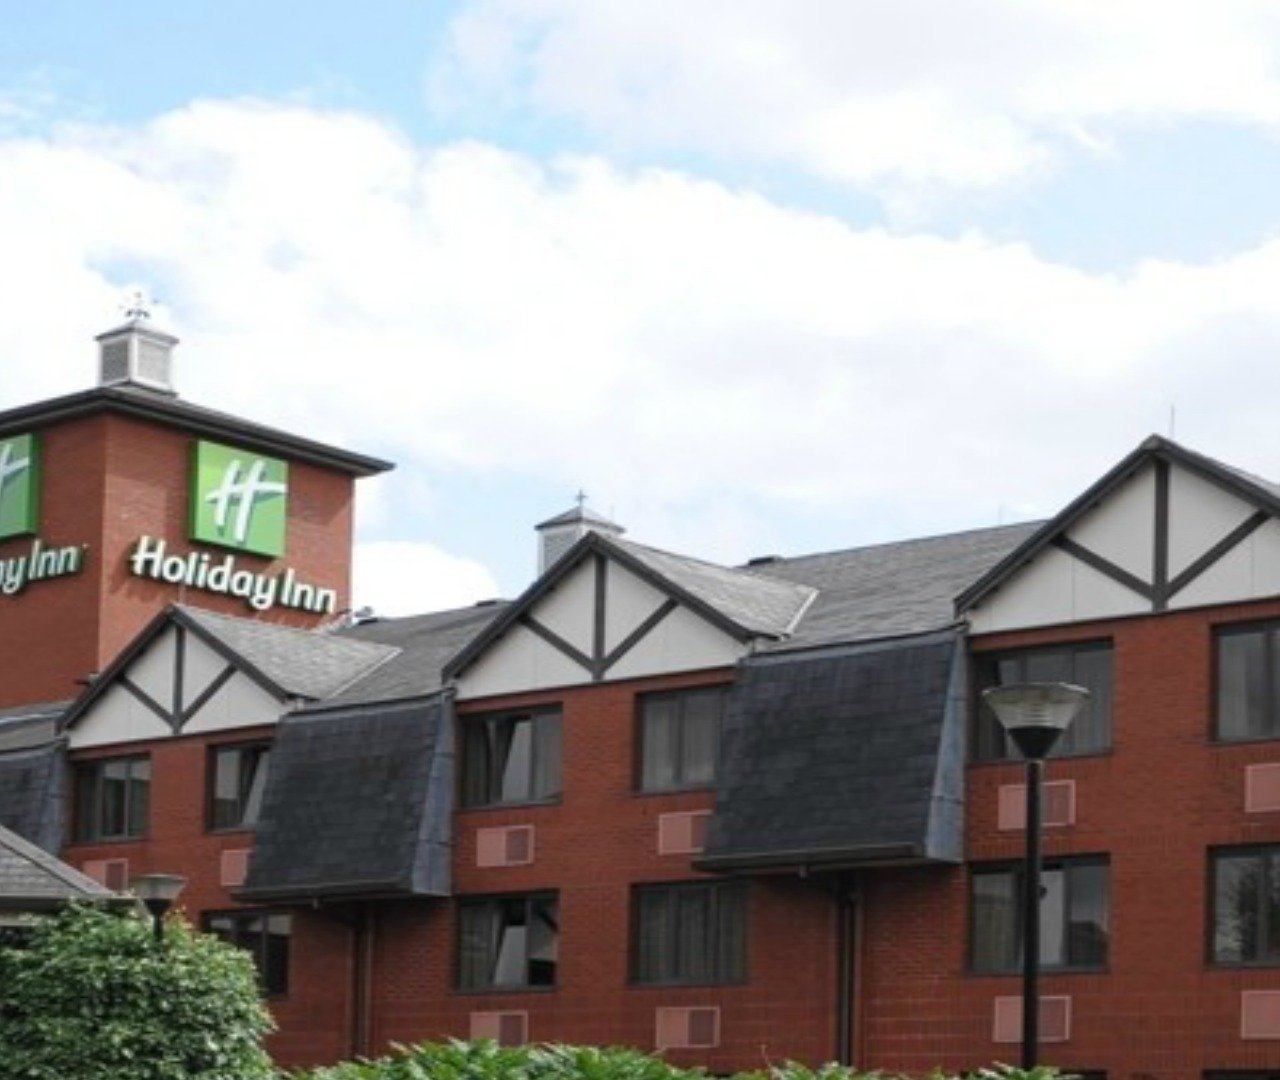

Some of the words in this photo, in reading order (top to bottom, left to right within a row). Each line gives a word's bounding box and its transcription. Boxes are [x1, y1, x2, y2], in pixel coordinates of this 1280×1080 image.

[28, 540, 80, 581] Inn
[132, 535, 278, 611] Holiday
[280, 568, 337, 613] Inn
